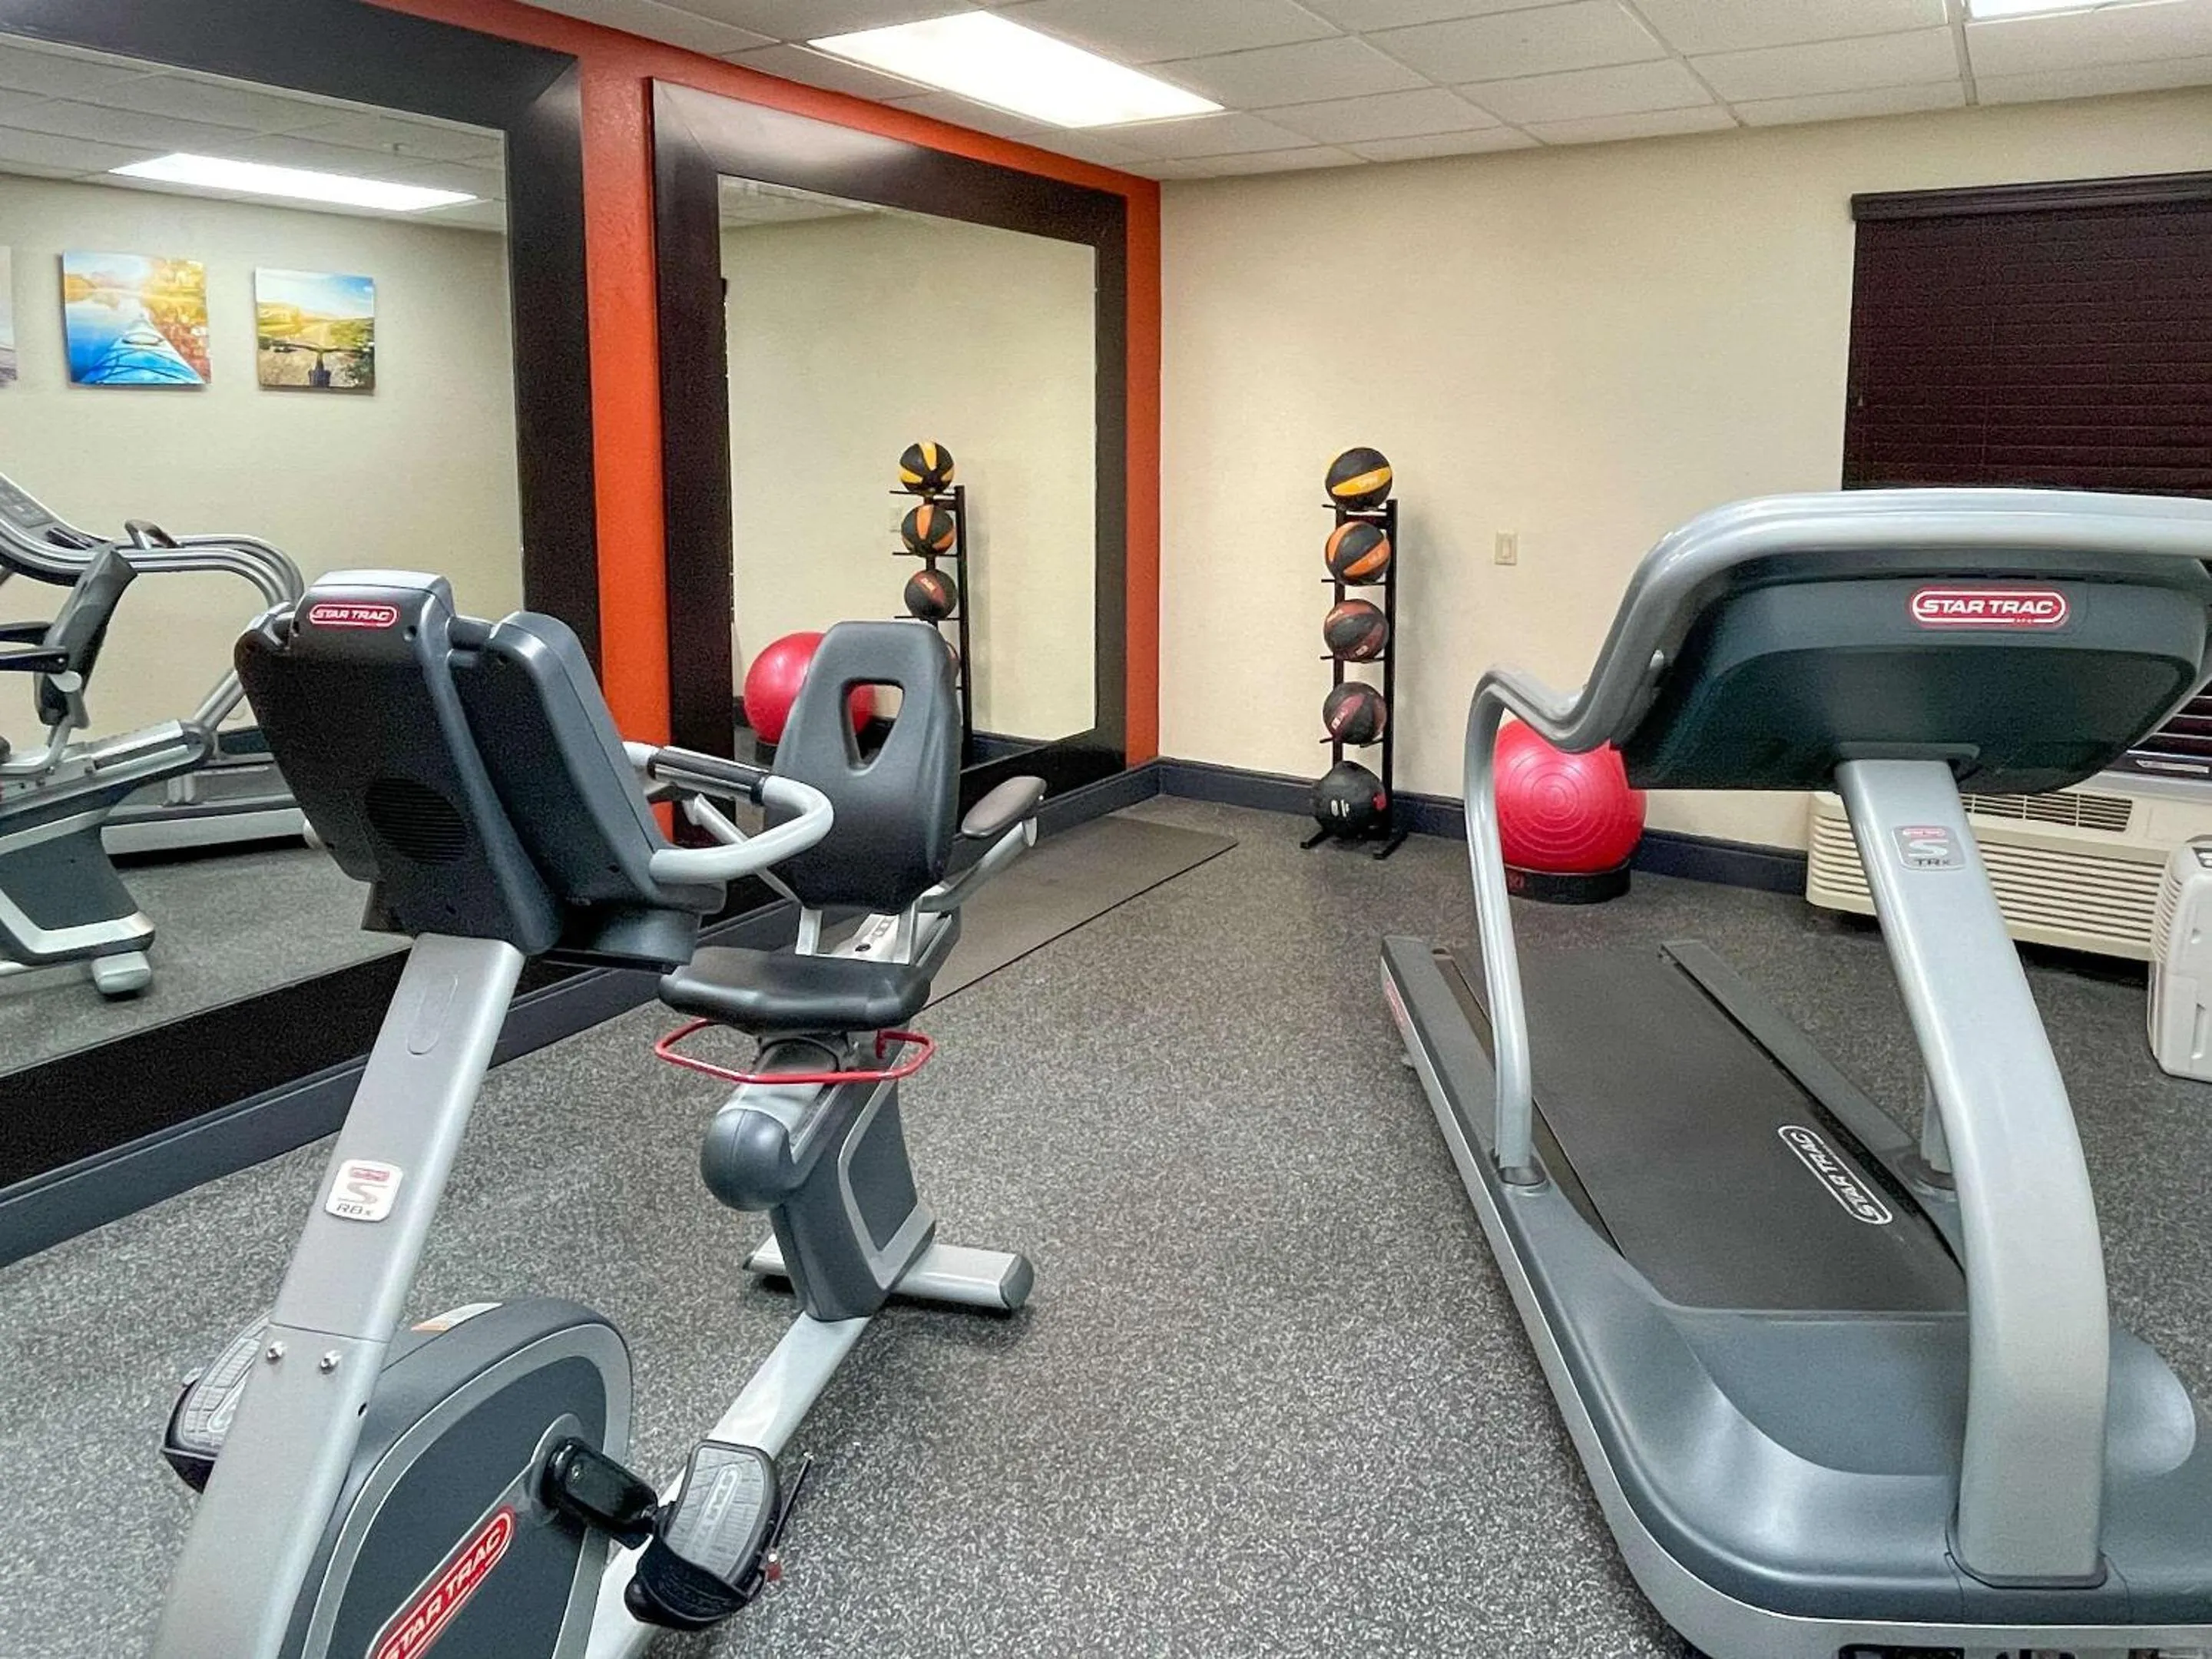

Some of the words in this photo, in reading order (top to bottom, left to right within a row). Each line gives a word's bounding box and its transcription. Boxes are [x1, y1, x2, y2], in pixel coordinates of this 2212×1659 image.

[315, 608, 349, 619] STAR
[349, 610, 390, 621] TRAC
[1922, 599, 1985, 614] STAR
[1985, 599, 2053, 614] TRAC
[1790, 1131, 1839, 1173] TRAC
[1828, 1174, 1880, 1218] STAR
[445, 1527, 501, 1599] TRAC
